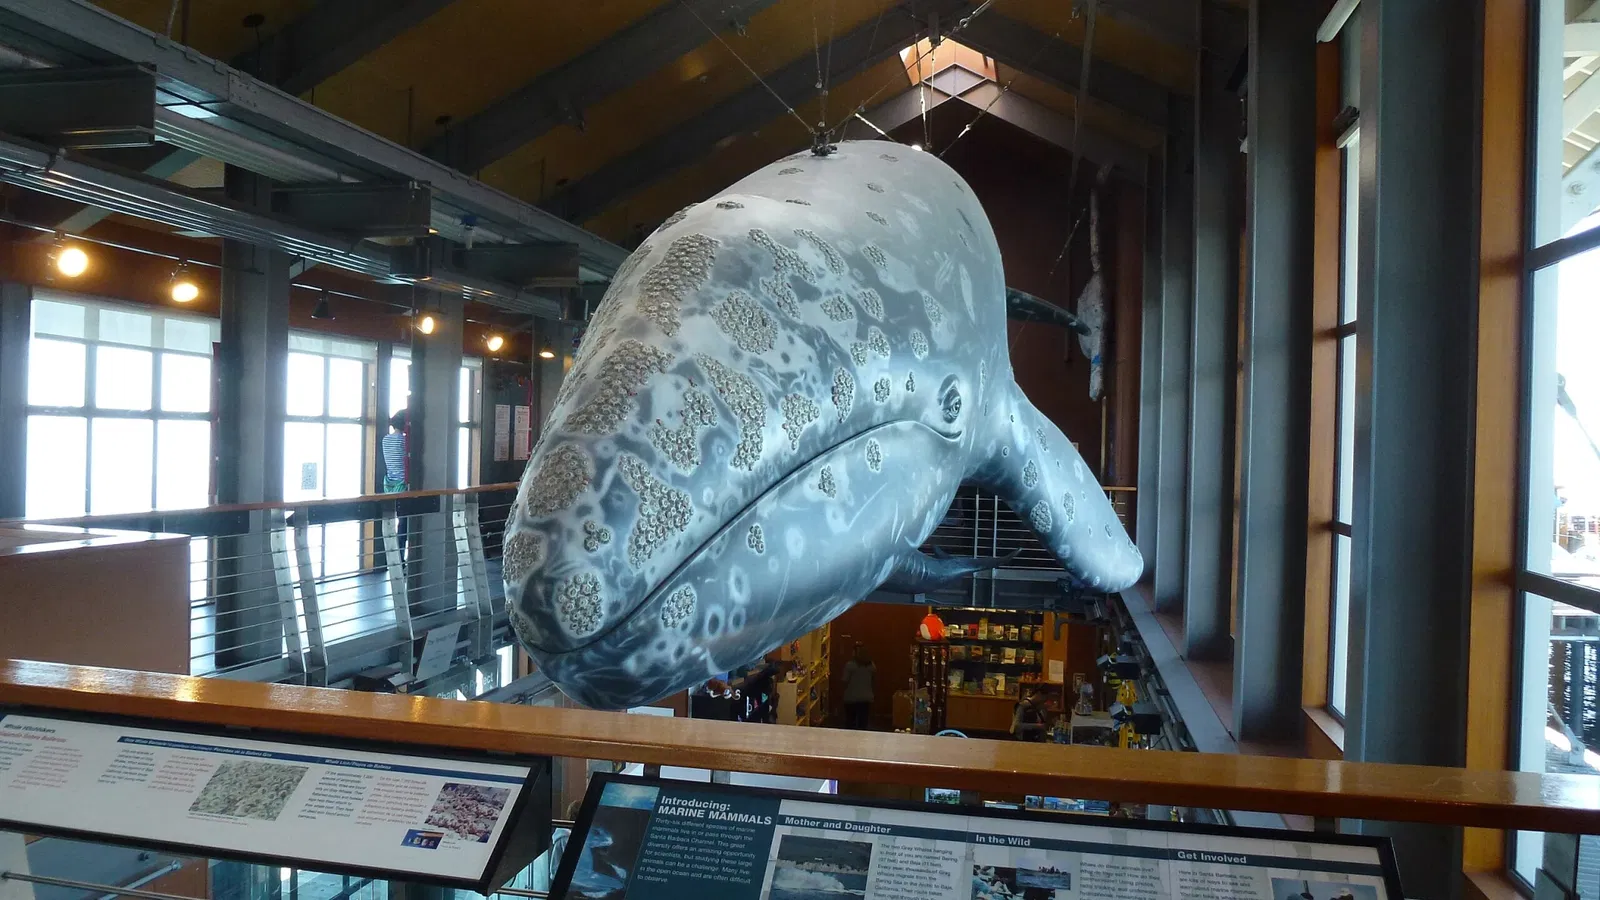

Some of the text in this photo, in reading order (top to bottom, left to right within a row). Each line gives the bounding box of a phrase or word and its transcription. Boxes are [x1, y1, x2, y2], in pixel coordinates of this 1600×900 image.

[661, 796, 730, 811] Introducing:
[658, 806, 772, 824] MARINE MAMMALS
[785, 817, 820, 827] Mother
[845, 823, 891, 833] Daughter
[1008, 837, 1030, 846] Wild
[1178, 851, 1246, 863] Get Involved
